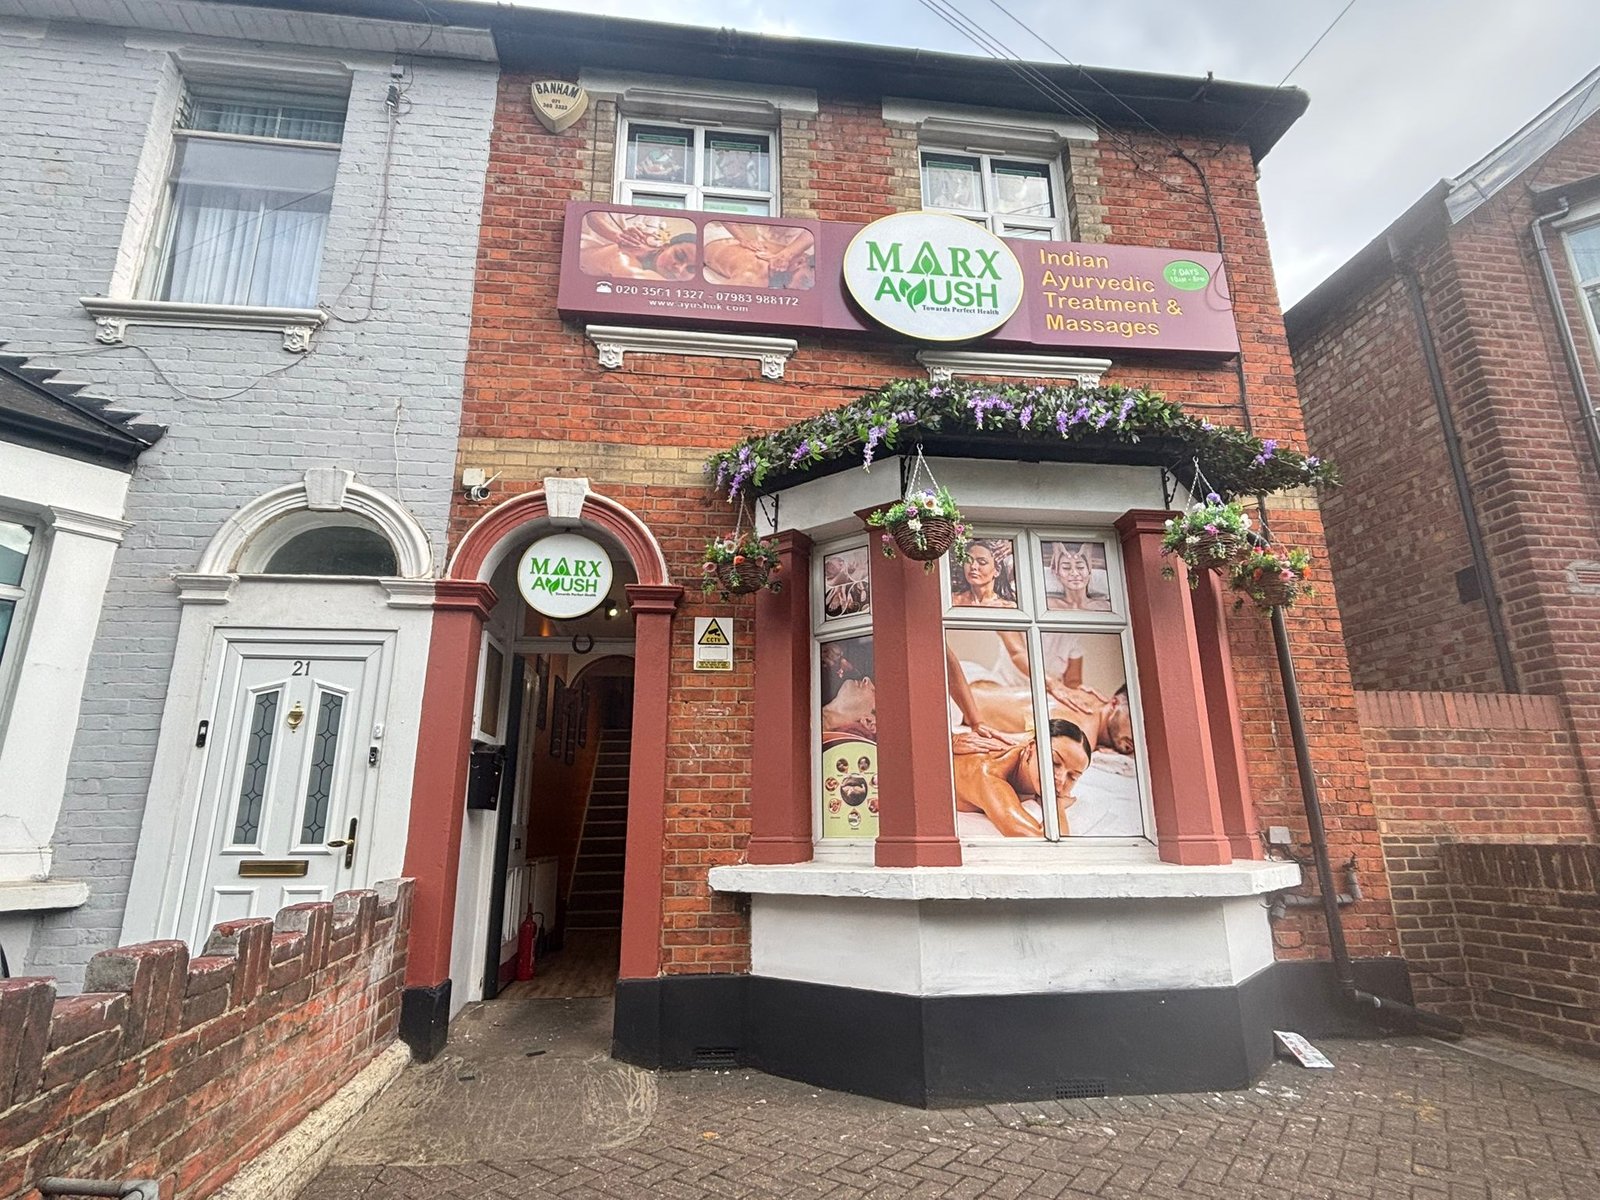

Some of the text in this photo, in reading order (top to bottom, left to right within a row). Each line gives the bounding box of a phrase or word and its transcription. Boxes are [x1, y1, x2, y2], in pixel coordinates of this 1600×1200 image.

[535, 83, 579, 98] BANHAM
[865, 241, 1003, 280] MARX
[1039, 248, 1109, 269] Indian
[1041, 270, 1156, 293] Ayurvedic
[1179, 268, 1200, 276] DAYS
[615, 285, 638, 295] 020
[642, 286, 671, 298] 3561
[676, 289, 704, 300] 1327
[716, 292, 752, 302] 07983
[755, 294, 799, 306] 988172
[874, 275, 999, 313] AYUSH
[1043, 291, 1183, 316] Treatment &
[922, 304, 951, 312] Towards
[952, 306, 976, 314] Perfect
[1046, 313, 1160, 338] Massages
[529, 557, 602, 578] MARX
[531, 576, 598, 596] AYUSH
[291, 660, 311, 677] 21
